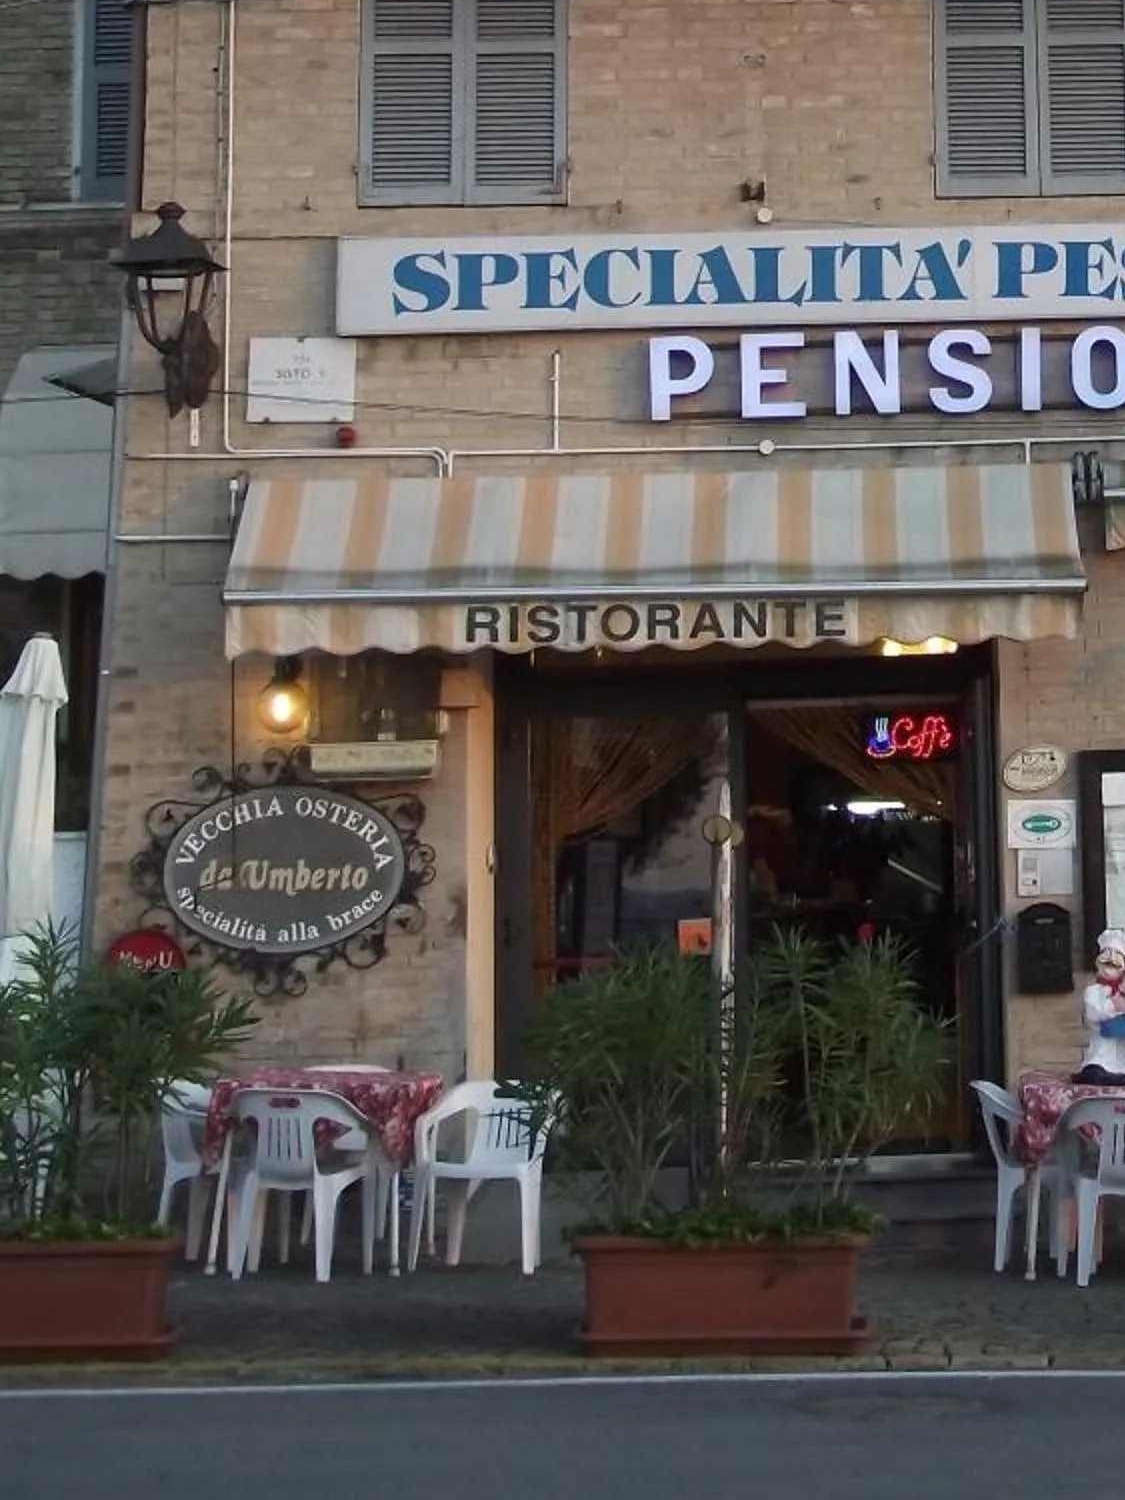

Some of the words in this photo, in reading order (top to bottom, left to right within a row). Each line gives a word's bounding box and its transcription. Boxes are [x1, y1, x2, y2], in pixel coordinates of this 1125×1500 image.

[392, 239, 972, 315] SPECIALITA'
[465, 601, 846, 643] RISTORANTE
[175, 797, 284, 866] VECCHIA
[295, 797, 394, 871] OSTERIA
[201, 859, 233, 891] da
[240, 859, 368, 896] Umberto
[277, 923, 320, 942] alla
[326, 888, 383, 931] brace
